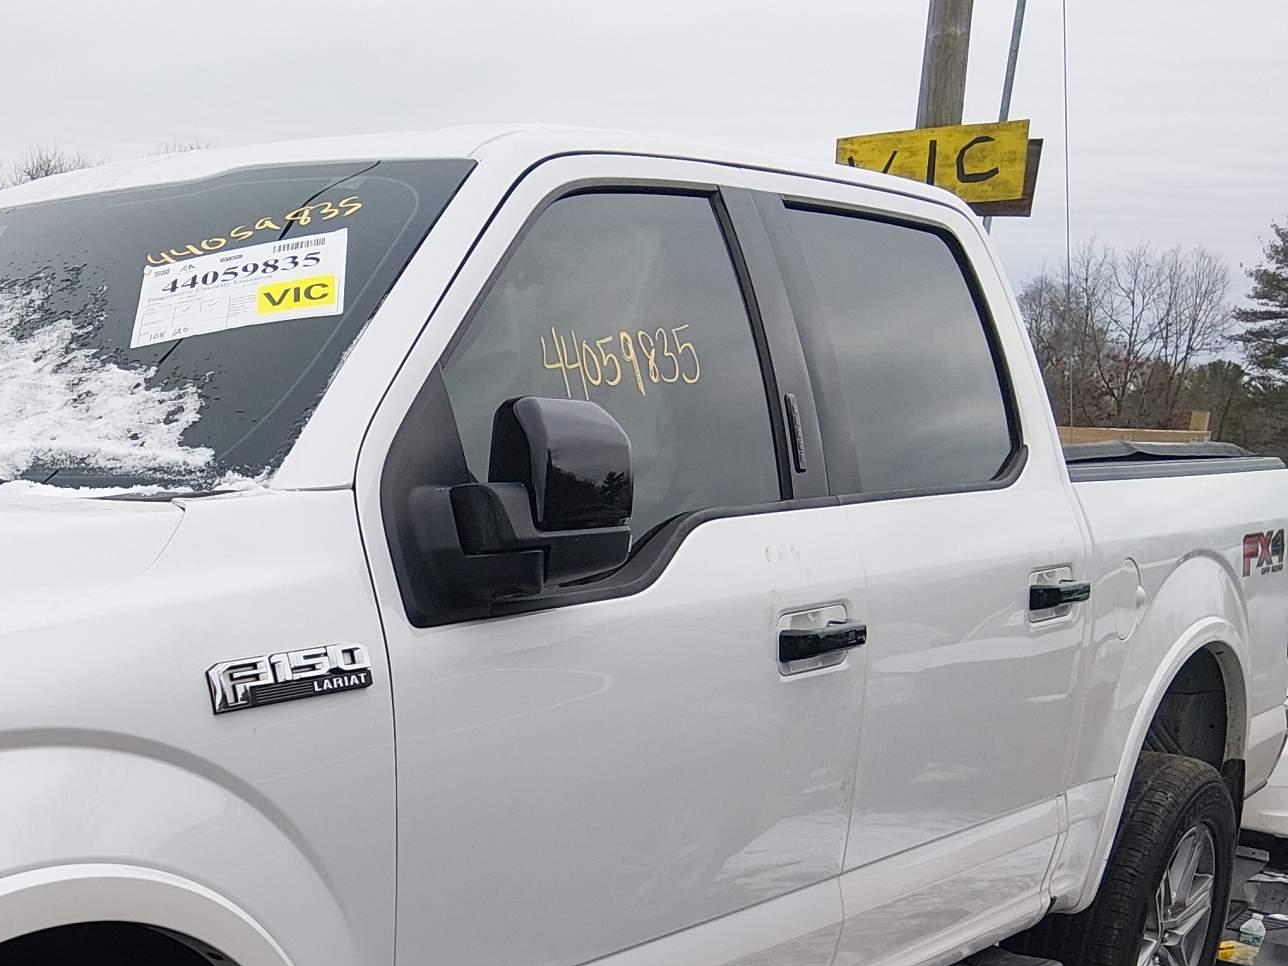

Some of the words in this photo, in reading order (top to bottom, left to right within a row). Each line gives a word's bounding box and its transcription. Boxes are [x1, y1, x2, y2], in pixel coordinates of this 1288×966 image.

[161, 251, 321, 292] 44059835
[263, 283, 329, 307] VIC
[540, 324, 701, 401] 44059835
[1242, 529, 1285, 577] FX4
[313, 673, 367, 692] LARIAT
